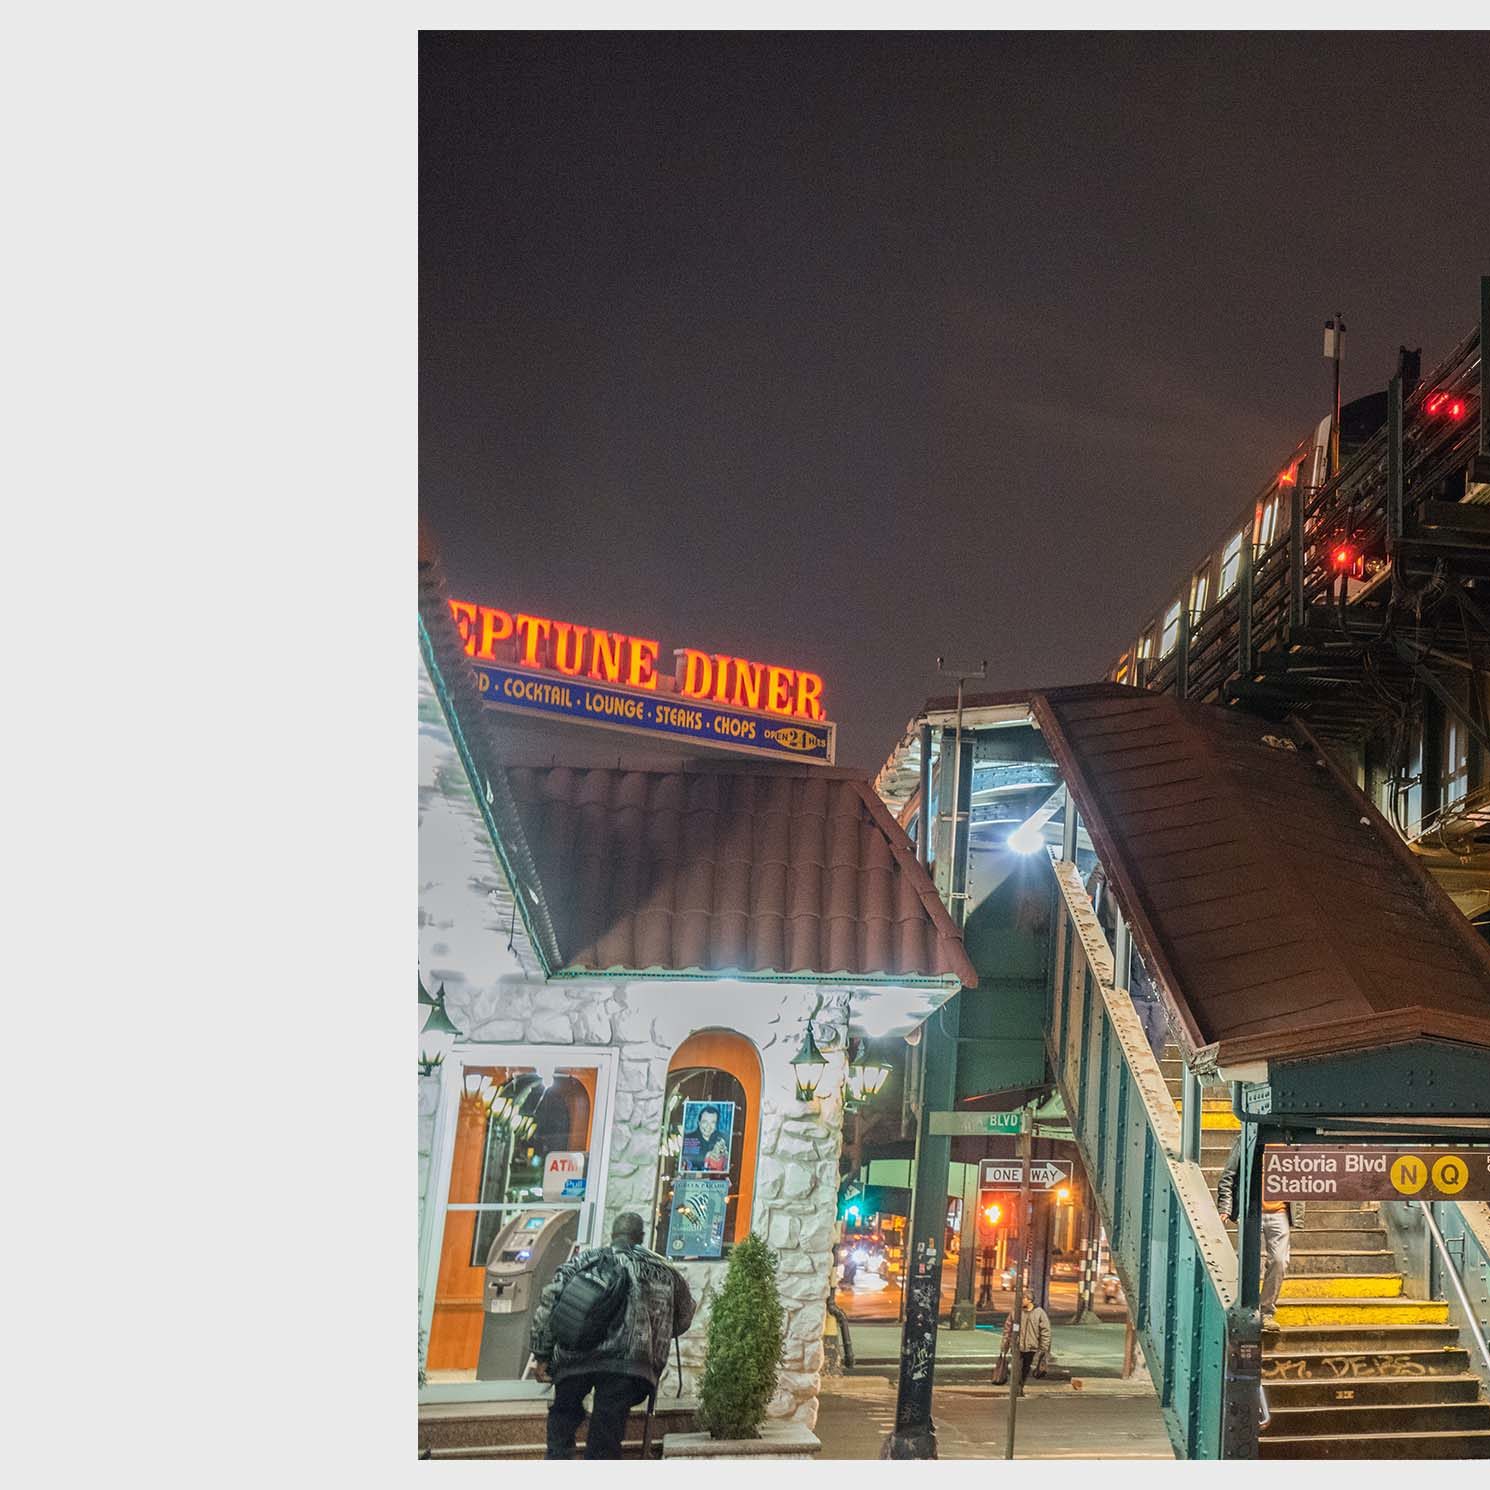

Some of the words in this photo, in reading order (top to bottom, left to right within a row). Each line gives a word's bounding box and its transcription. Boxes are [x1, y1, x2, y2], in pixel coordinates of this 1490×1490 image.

[681, 648, 827, 721] DINER
[503, 678, 573, 708] COCKTAIL
[585, 692, 644, 720] LOUNGE
[655, 705, 703, 731] STEAKS
[714, 715, 757, 740] CHOPS
[989, 1114, 1018, 1127] BLVD
[1267, 1154, 1337, 1173] Astoria
[1345, 1154, 1387, 1173] Blvd
[993, 1169, 1020, 1181] ONE
[1031, 1170, 1058, 1181] WAY
[1400, 1164, 1418, 1185] N
[1440, 1164, 1459, 1185] Q
[1266, 1175, 1337, 1194] Station
